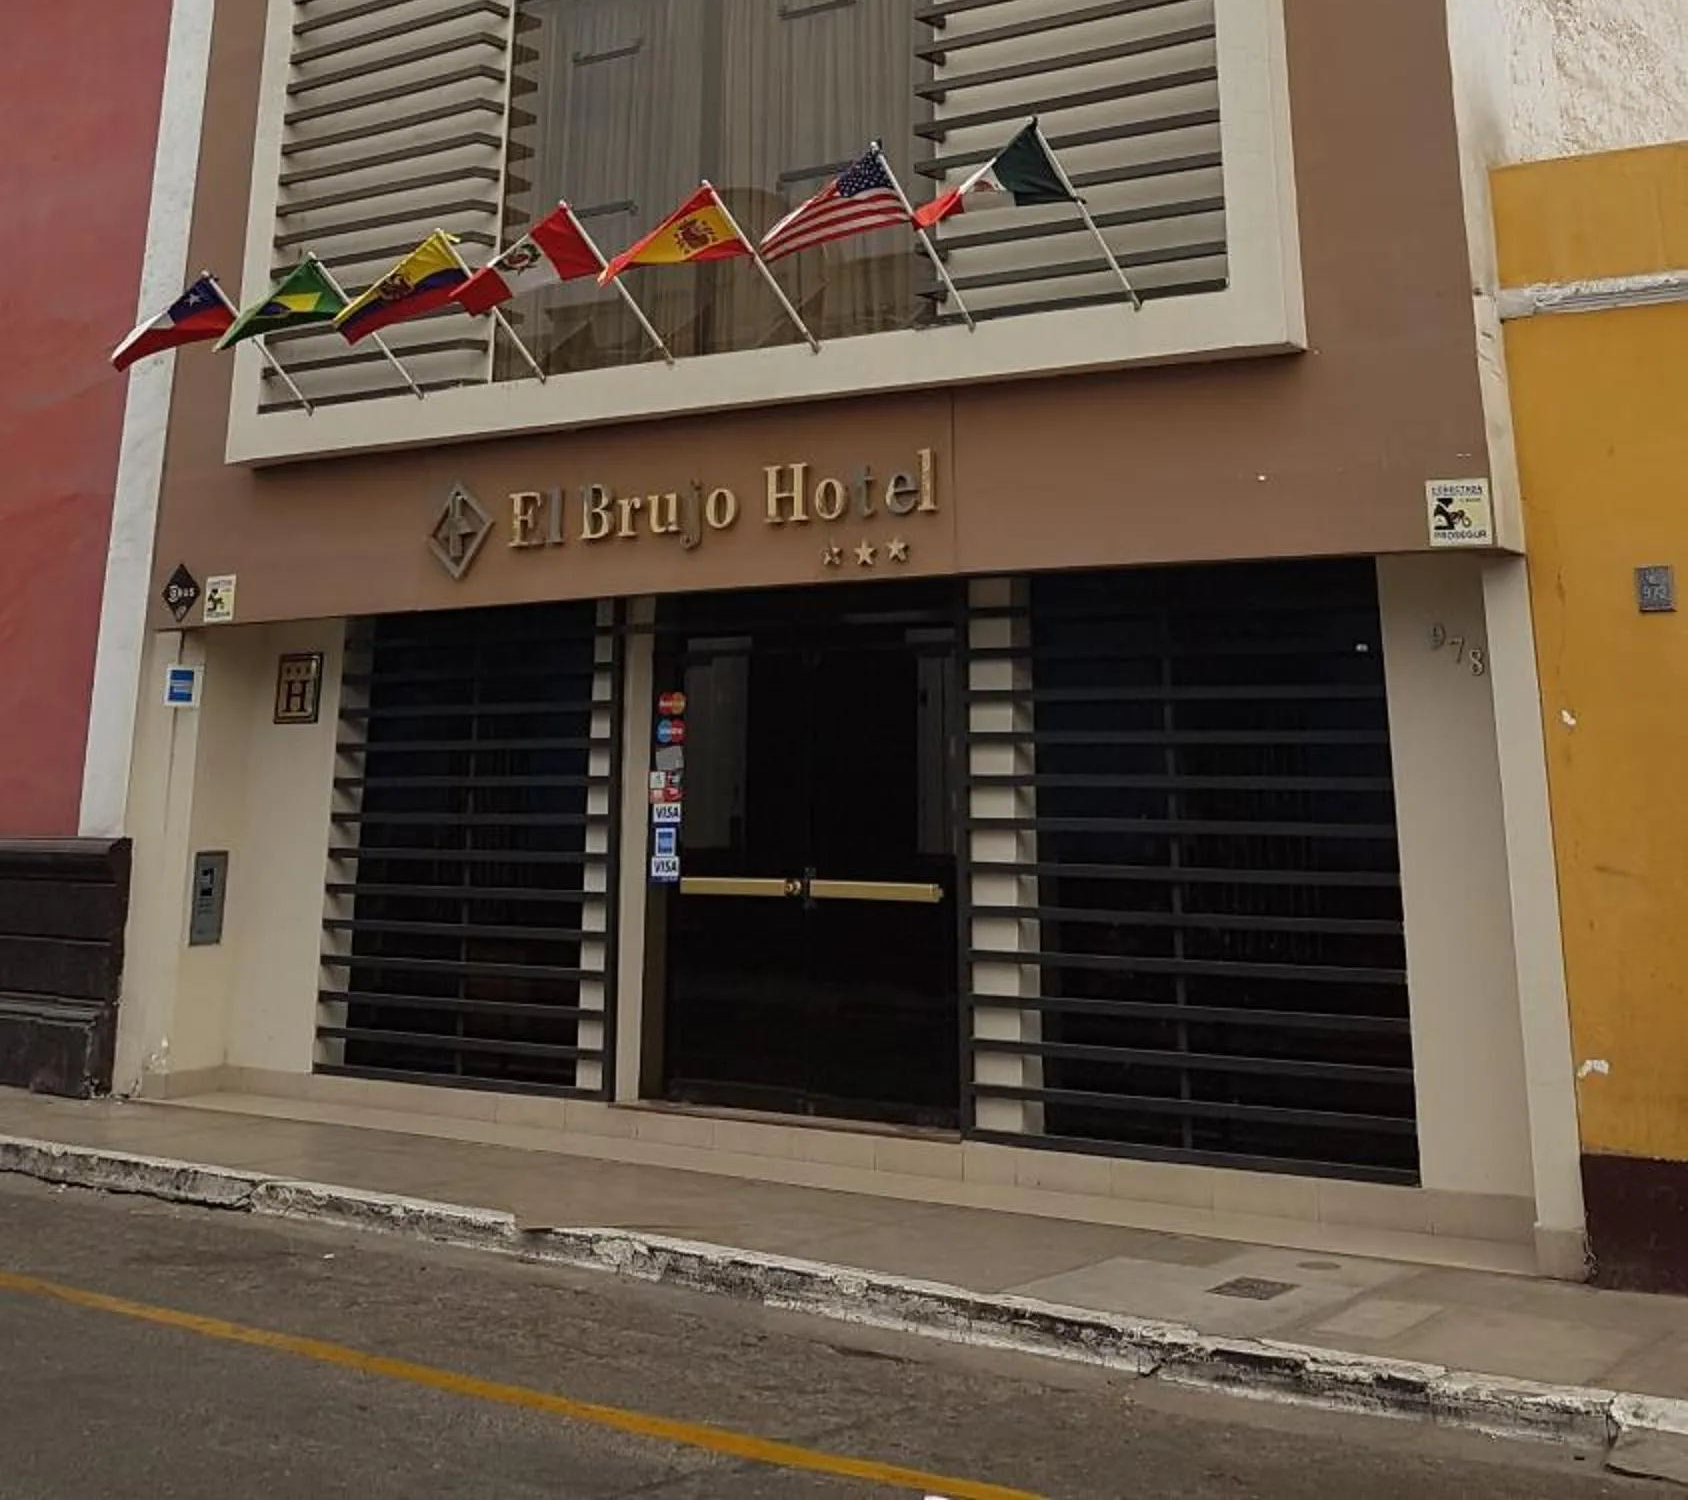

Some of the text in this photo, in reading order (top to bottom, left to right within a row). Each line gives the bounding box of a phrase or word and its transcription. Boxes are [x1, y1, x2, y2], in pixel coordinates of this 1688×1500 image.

[508, 448, 938, 549] El Brujo Hotel
[1430, 623, 1485, 676] 978
[281, 680, 310, 712] H
[656, 807, 680, 819] VISA
[654, 859, 678, 872] VISA
